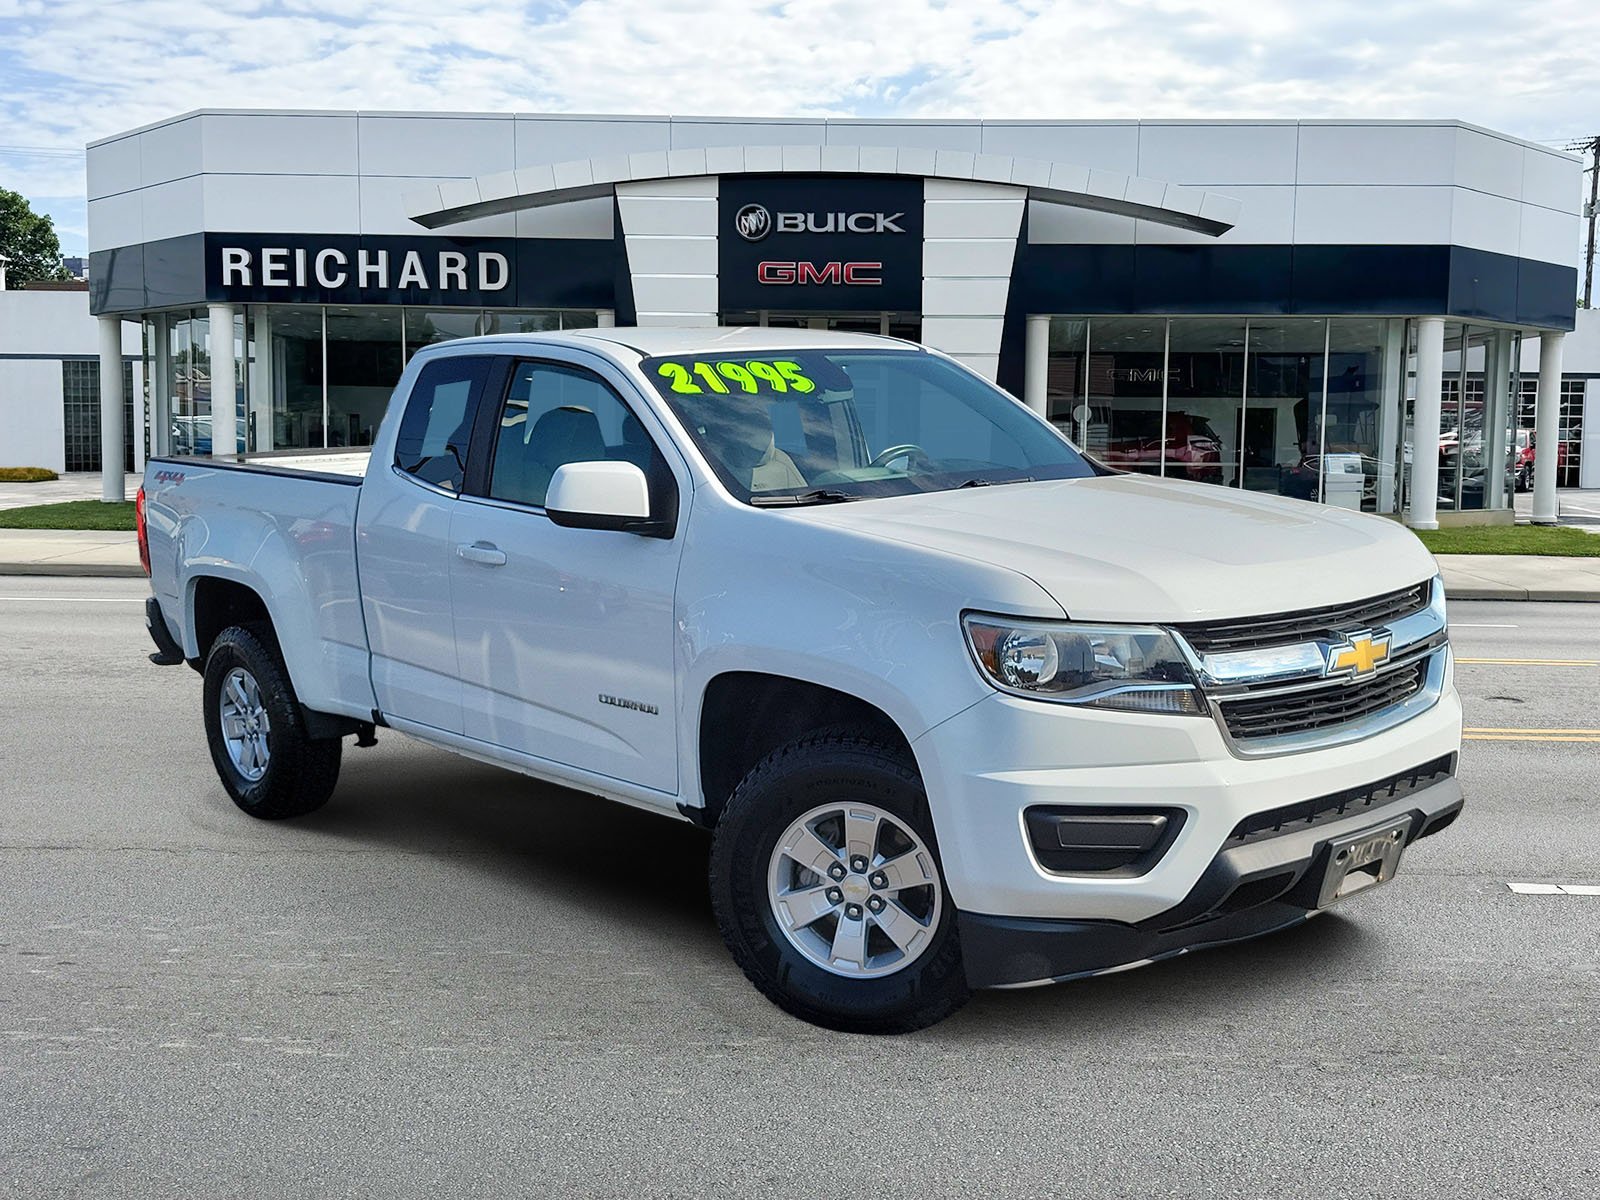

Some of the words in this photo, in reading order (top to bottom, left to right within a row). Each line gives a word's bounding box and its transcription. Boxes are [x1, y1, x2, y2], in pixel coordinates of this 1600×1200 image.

[776, 212, 906, 233] BUICK
[221, 247, 510, 291] REICHARD
[757, 261, 882, 285] GMC
[657, 361, 816, 394] 21995
[1106, 368, 1181, 382] GMC
